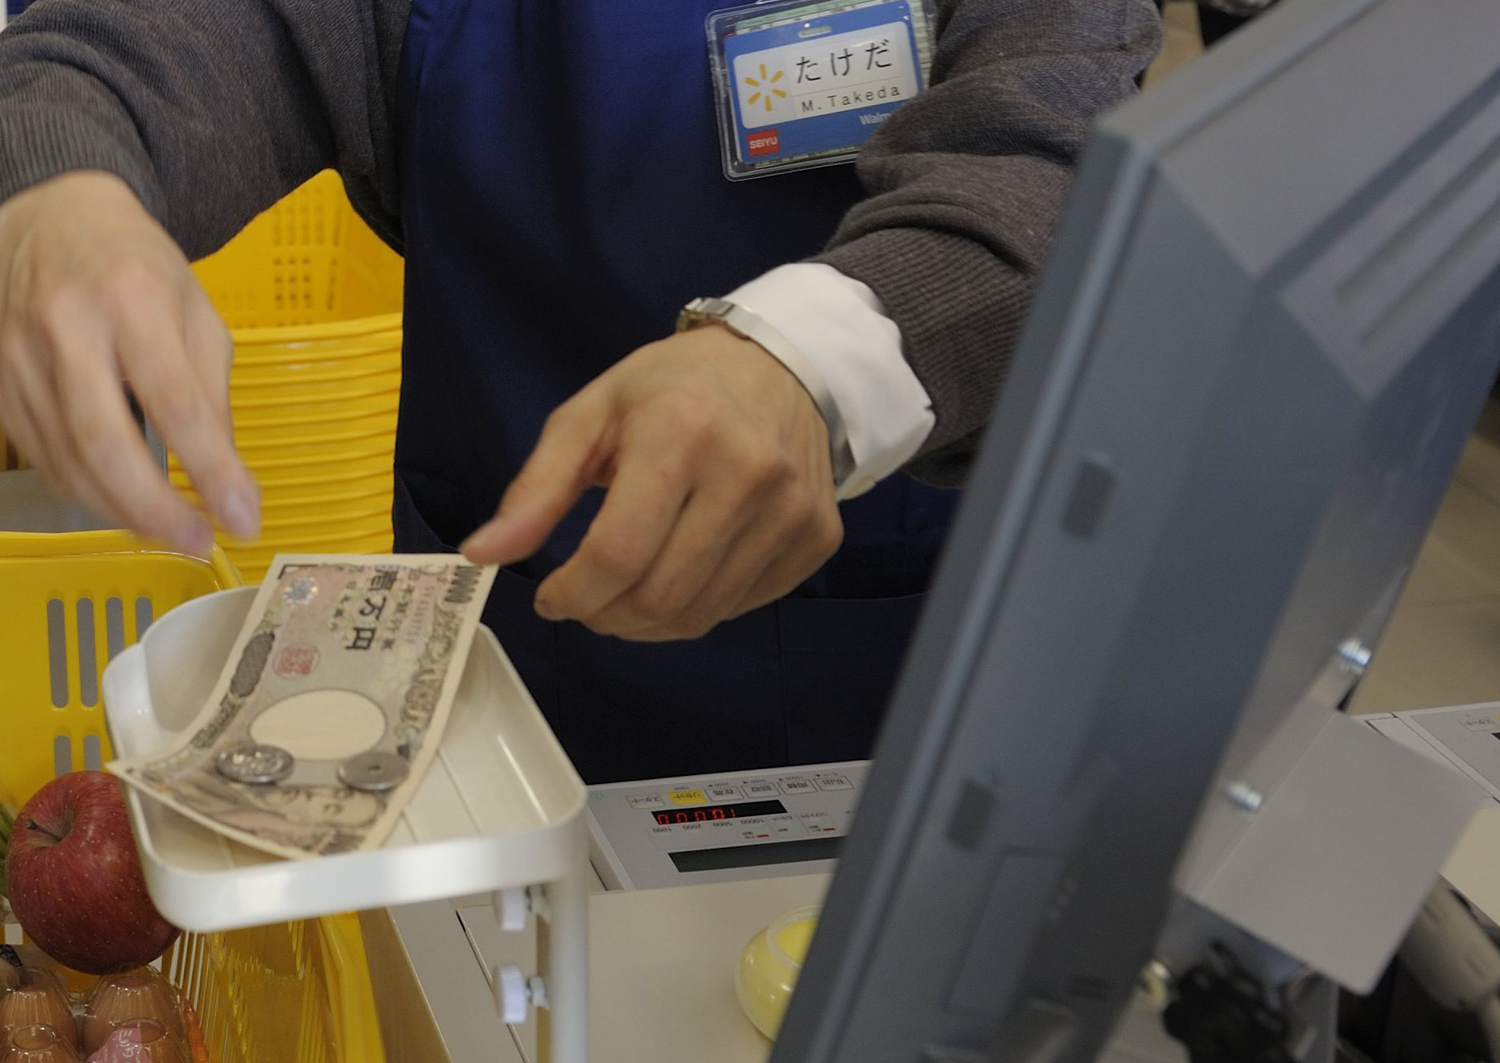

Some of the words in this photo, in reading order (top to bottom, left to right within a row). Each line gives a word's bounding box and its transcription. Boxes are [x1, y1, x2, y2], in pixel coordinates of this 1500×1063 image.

[797, 39, 892, 83] たけだ
[802, 100, 822, 112] M.
[828, 86, 901, 108] Takeda
[749, 136, 778, 149] SEIYU
